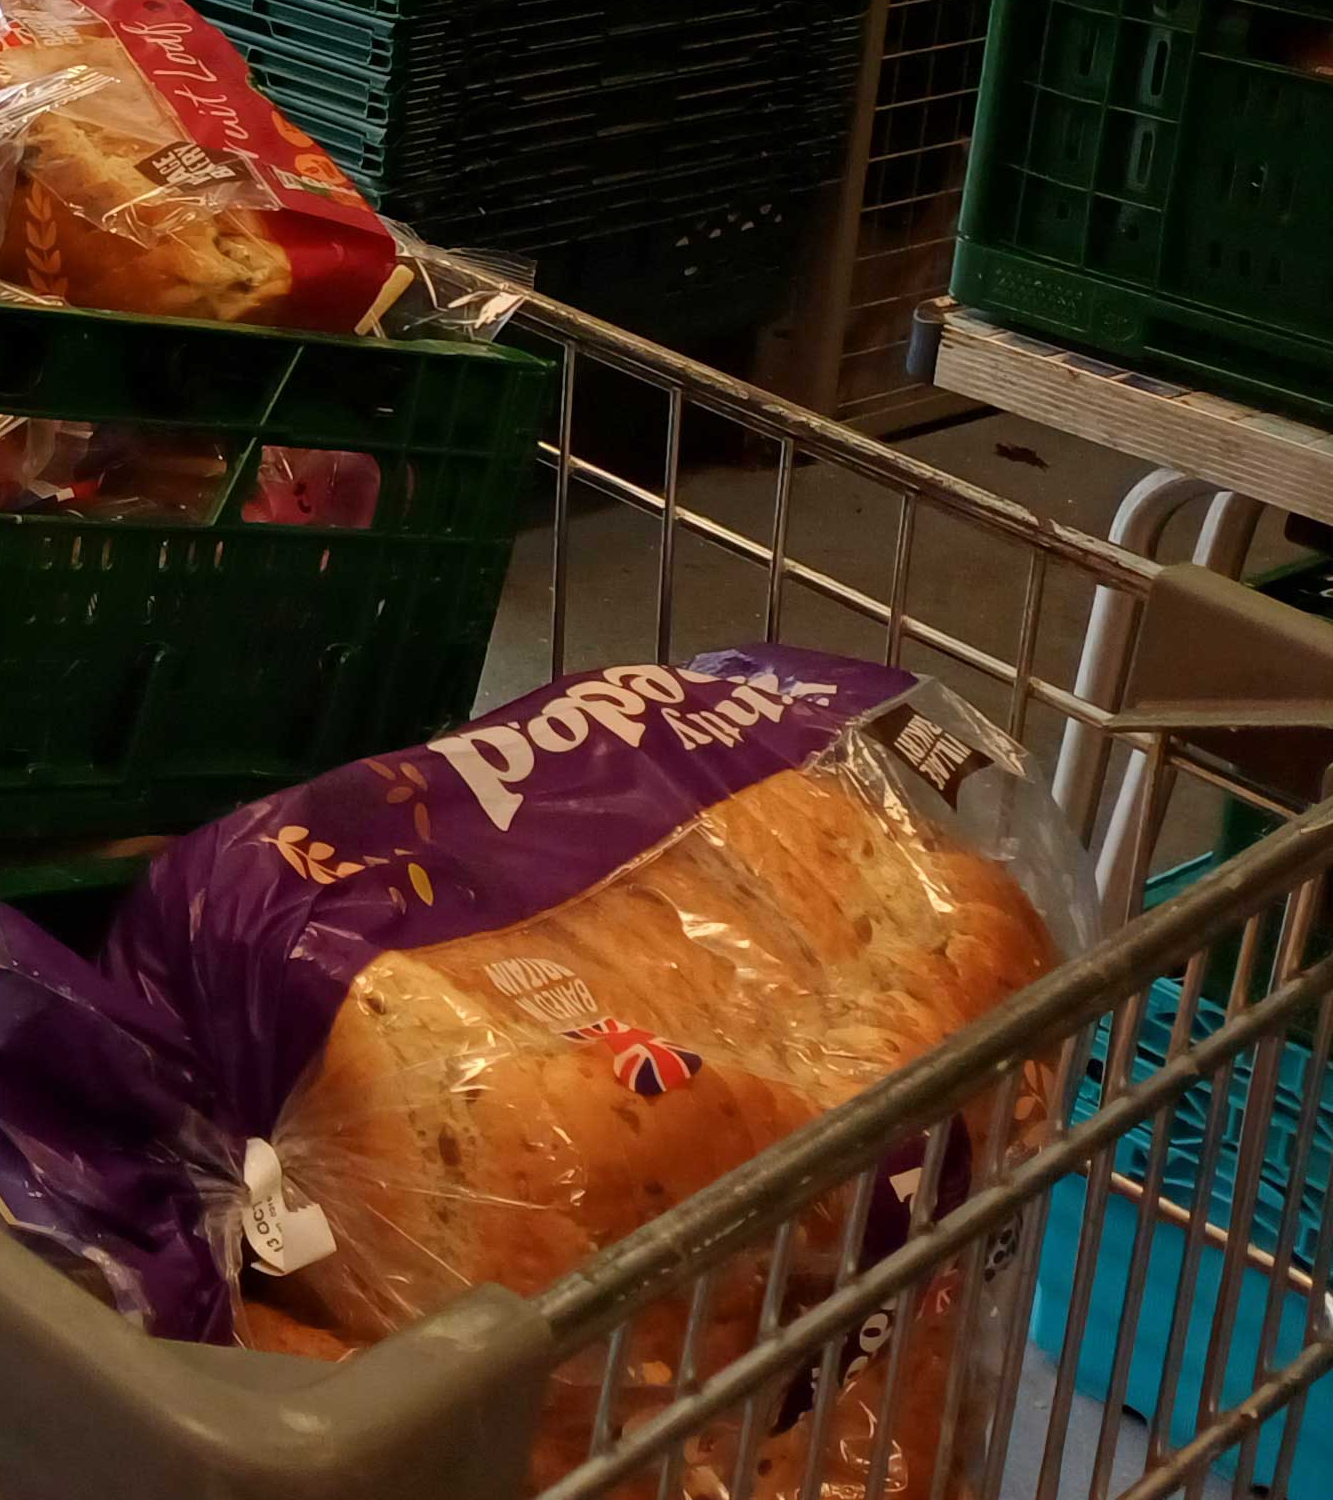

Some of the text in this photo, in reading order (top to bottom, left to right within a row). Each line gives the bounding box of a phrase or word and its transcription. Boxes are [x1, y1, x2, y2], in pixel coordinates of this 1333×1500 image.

[119, 20, 218, 82] Loaf
[482, 956, 576, 997] BRITAIN
[533, 978, 598, 1019] BAKED
